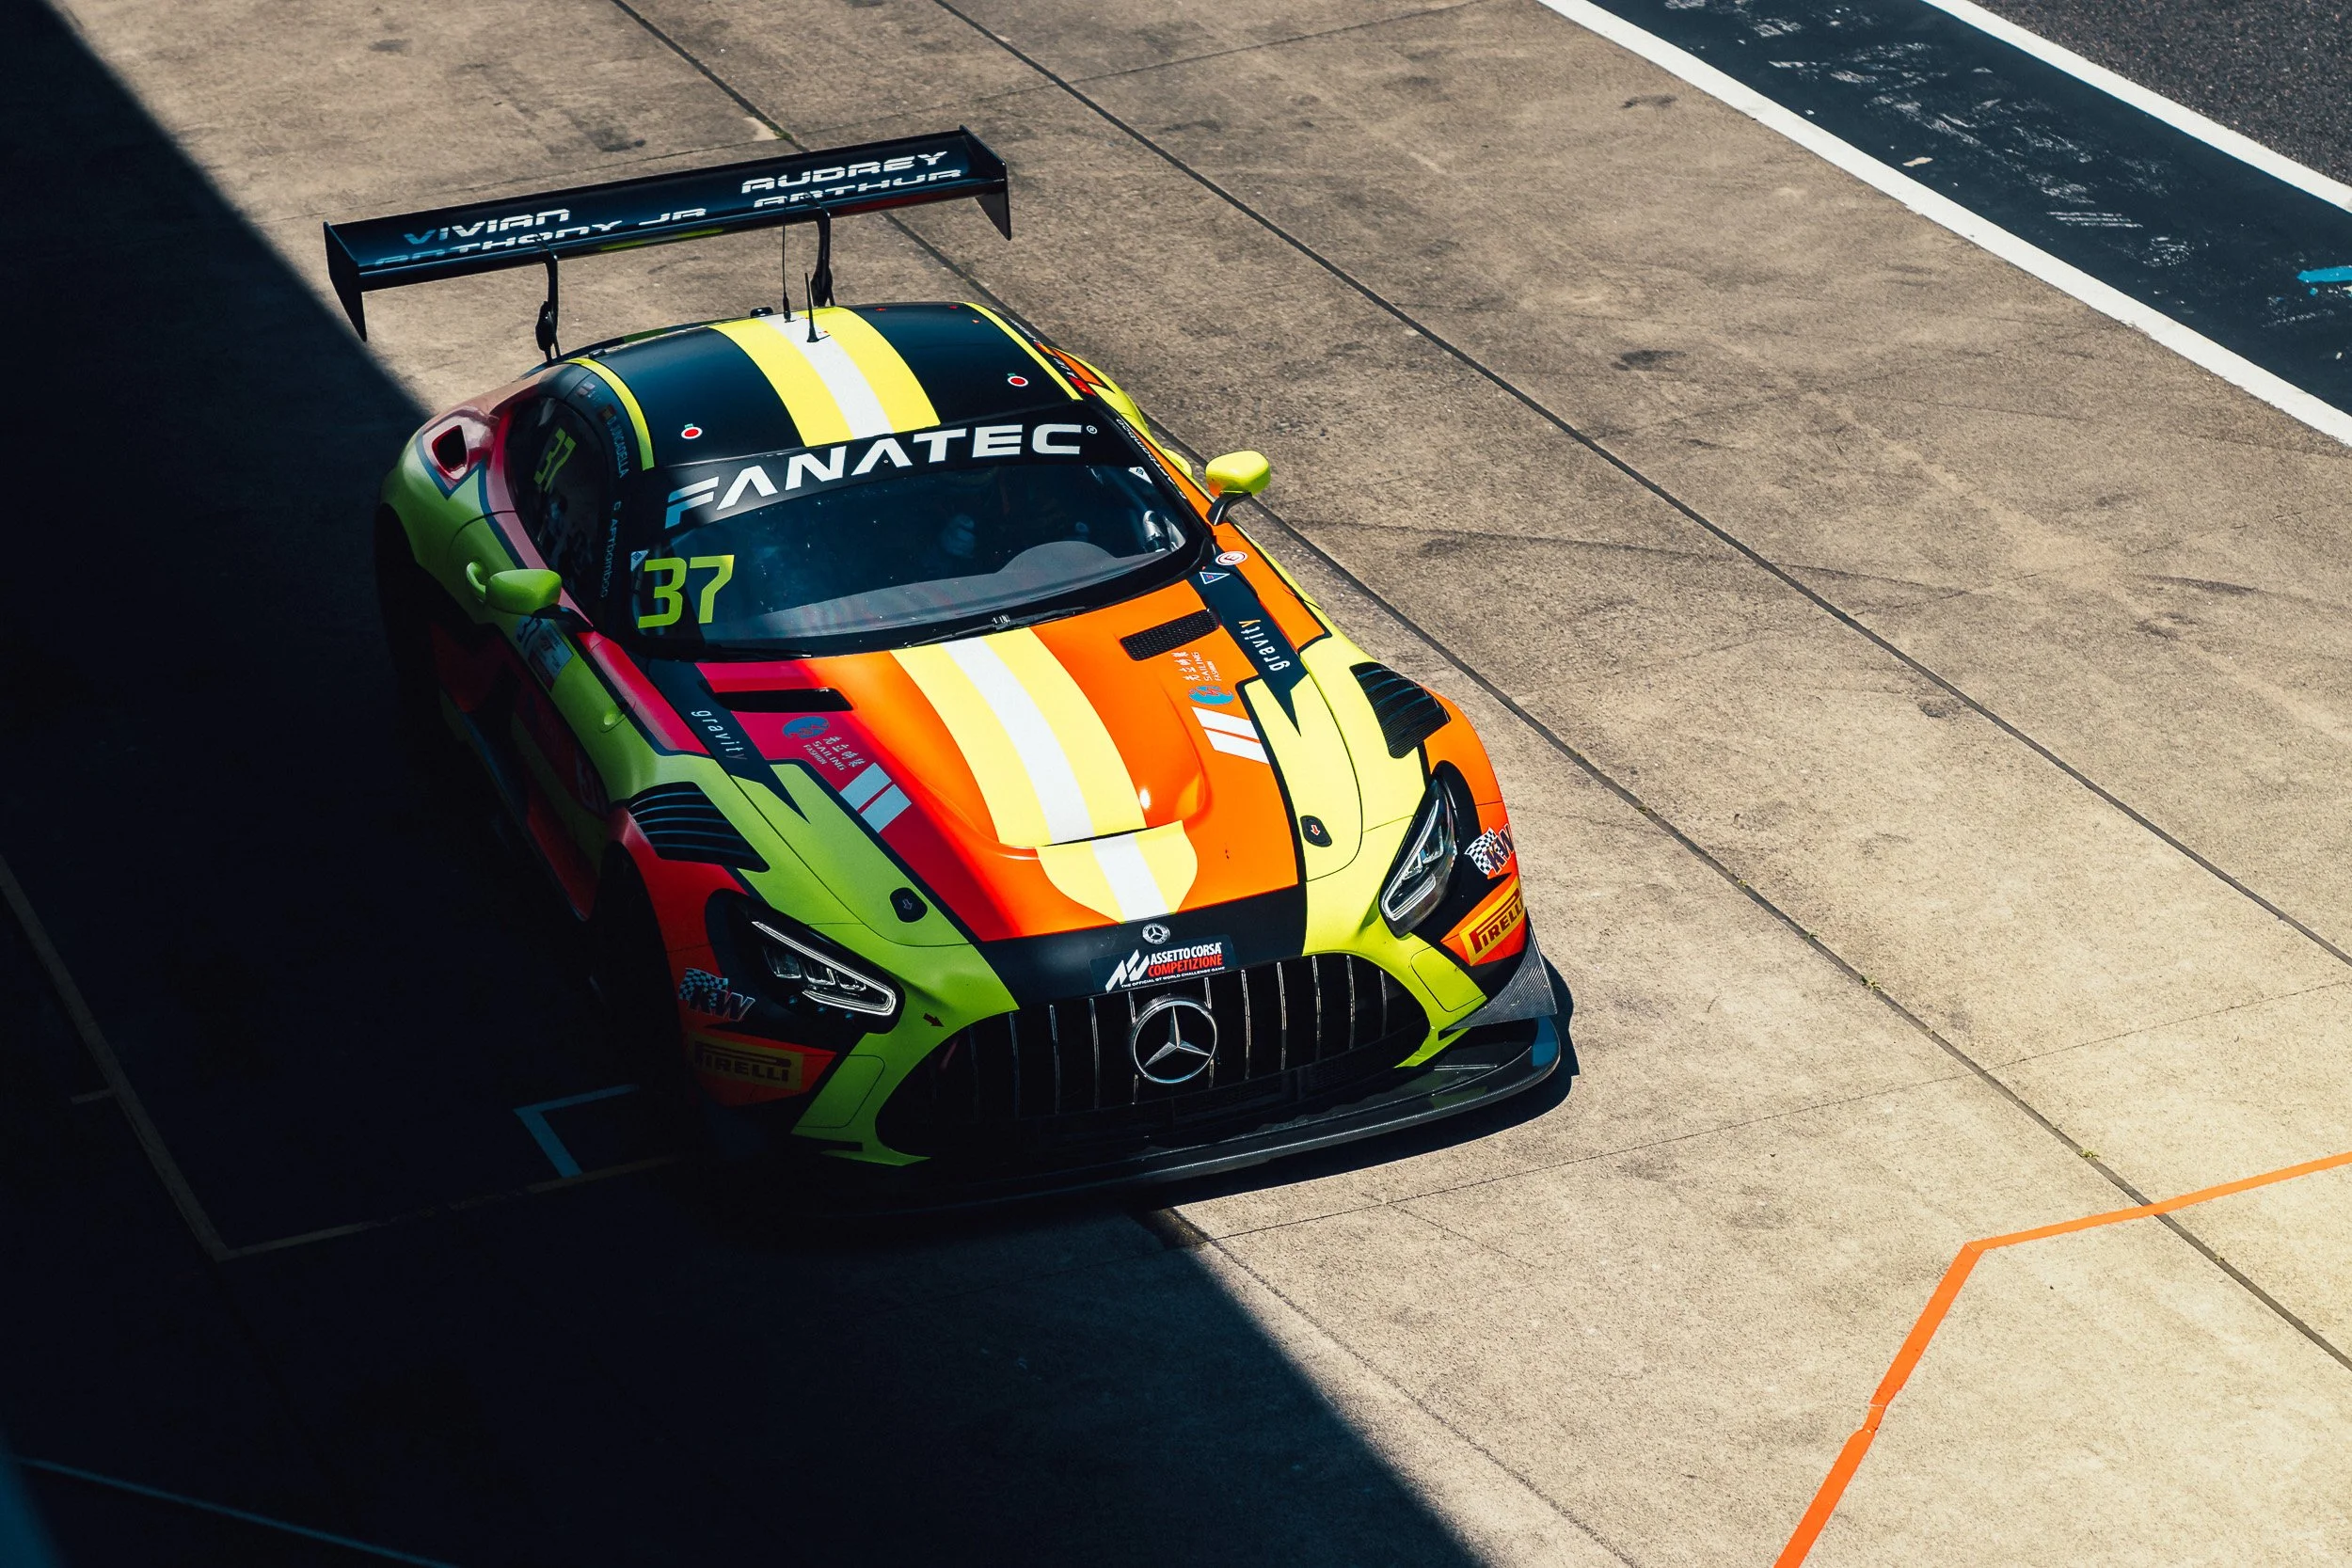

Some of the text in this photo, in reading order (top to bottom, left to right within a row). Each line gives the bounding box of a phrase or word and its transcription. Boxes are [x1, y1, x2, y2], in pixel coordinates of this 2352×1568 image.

[740, 150, 947, 194] AUDREY
[753, 169, 961, 208] ARTHUR
[374, 208, 707, 266] ANTHONY JR
[404, 208, 570, 245] VIVIAN
[637, 554, 735, 629] 37
[1238, 619, 1291, 672] gravity
[1190, 651, 1213, 682] SAILING
[691, 710, 747, 760] gravity
[812, 740, 847, 771] SAILING
[1484, 824, 1516, 874] KW
[1147, 954, 1222, 977] COMPETIZIONE
[1150, 942, 1222, 966] ASSETTO CORSA
[1132, 978, 1155, 987] OFFICIAL
[1181, 968, 1211, 977] CHALLENGE
[686, 984, 756, 1022] KW
[694, 1040, 792, 1083] PIRELLI
